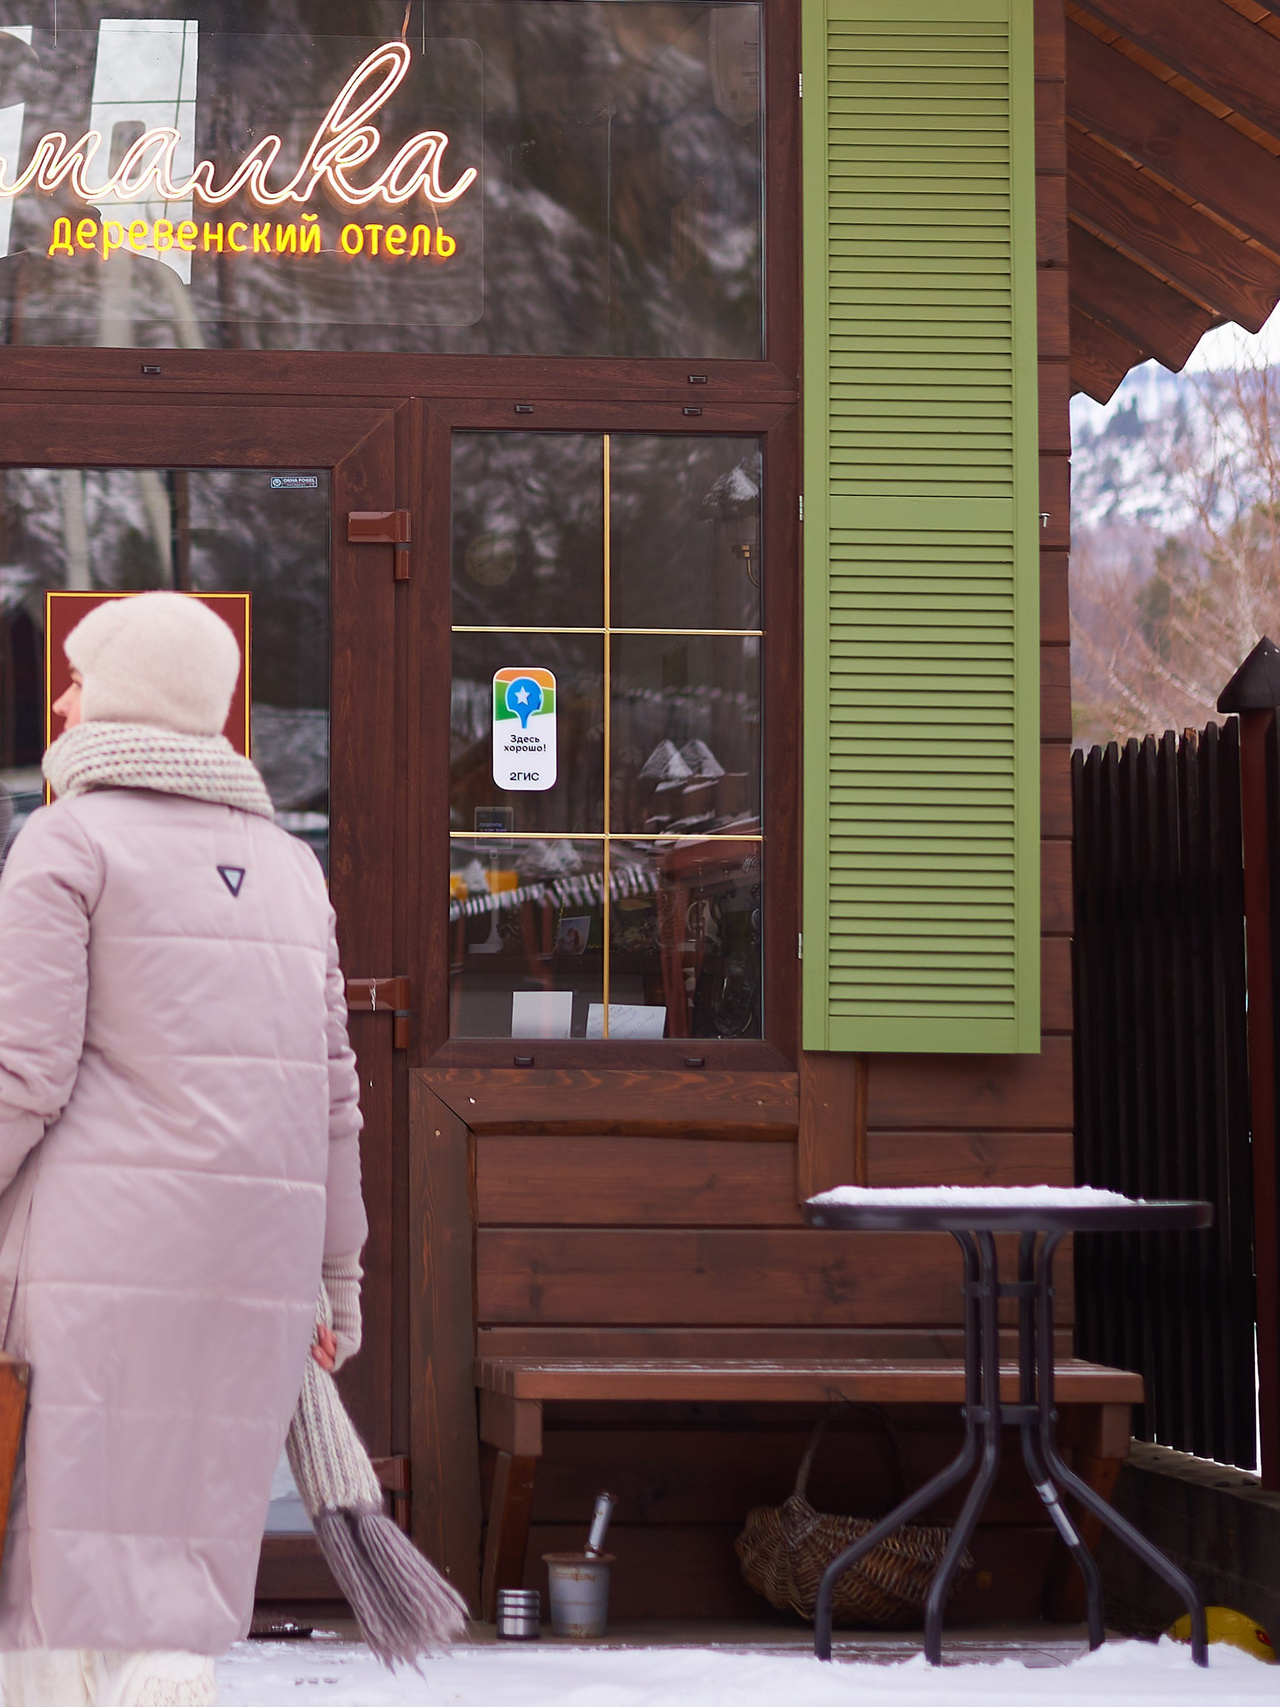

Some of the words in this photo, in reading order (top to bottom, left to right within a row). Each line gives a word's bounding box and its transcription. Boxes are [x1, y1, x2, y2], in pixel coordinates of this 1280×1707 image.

[48, 213, 322, 261] деревенский
[341, 223, 457, 257] отель
[510, 734, 540, 744] Здесь
[504, 744, 546, 753] хорошо!
[509, 771, 540, 781] 2ГИС
